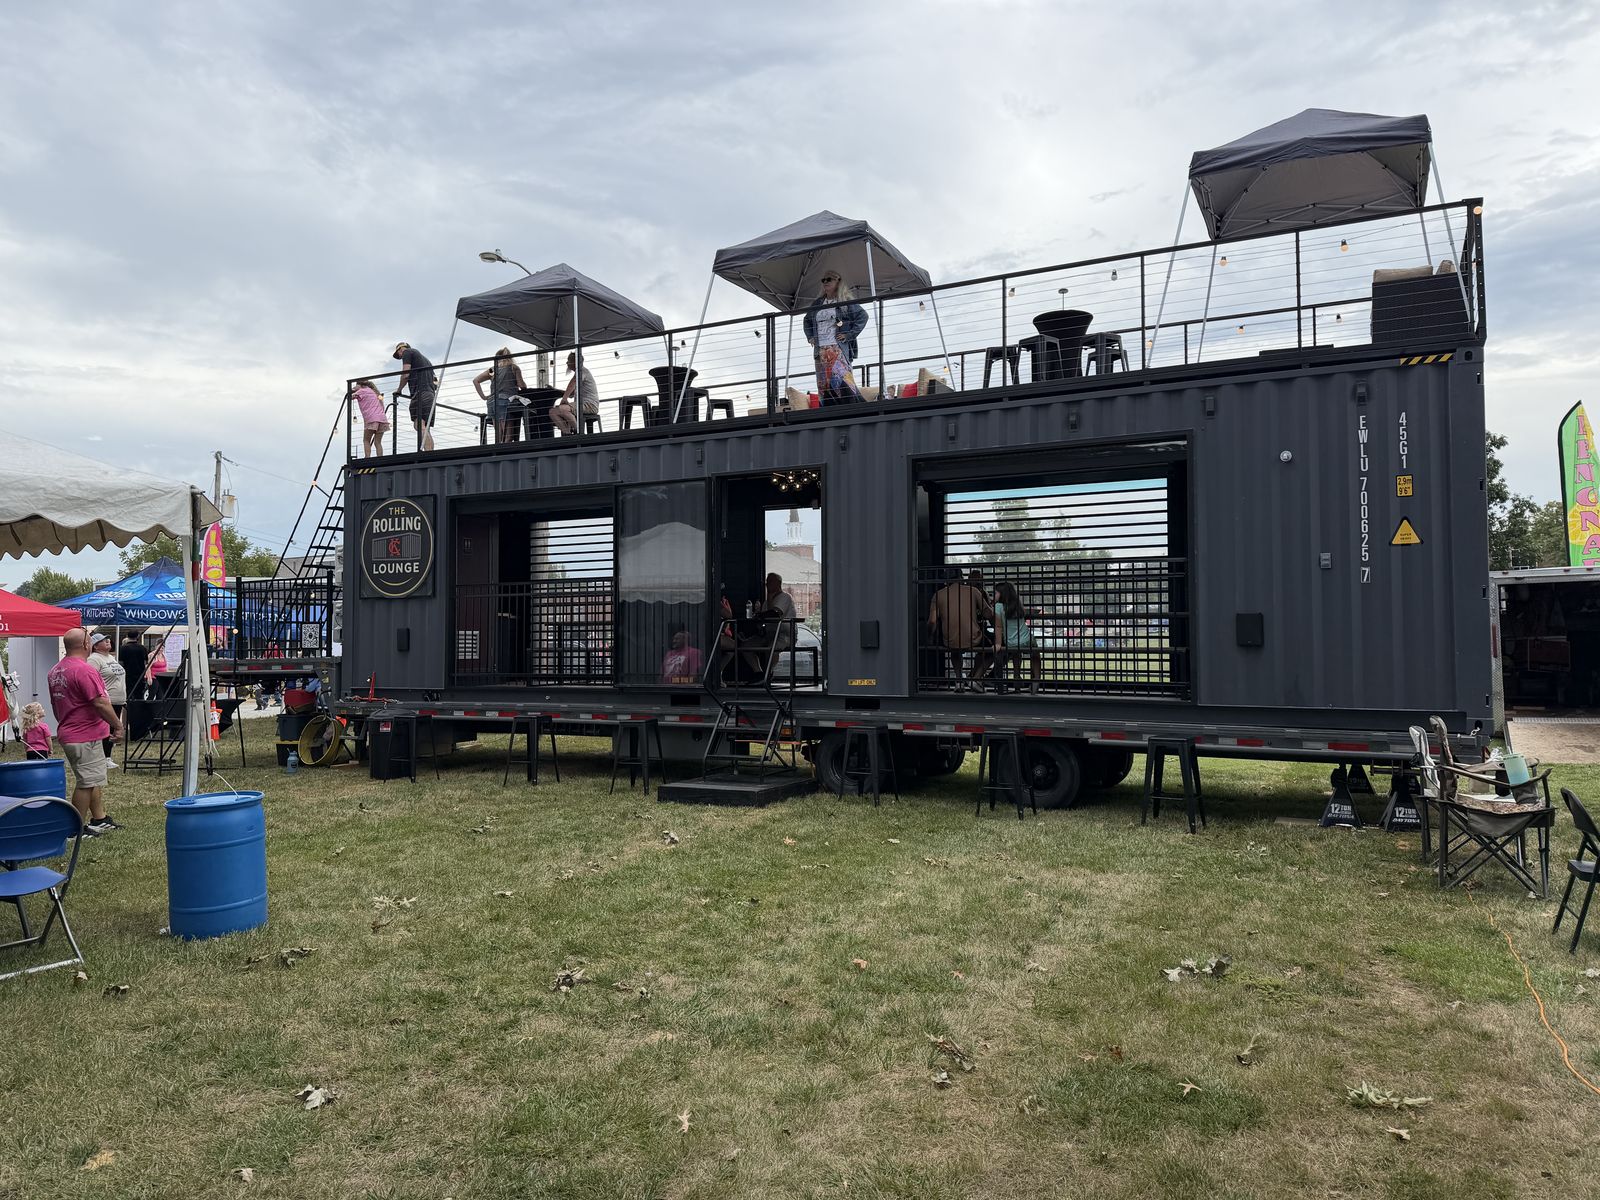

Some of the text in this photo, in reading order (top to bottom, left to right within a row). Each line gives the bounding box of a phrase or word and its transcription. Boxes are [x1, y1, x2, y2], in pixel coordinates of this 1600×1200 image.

[1399, 411, 1408, 469] 45G1
[1358, 415, 1370, 583] EWLU 700625 7
[388, 507, 406, 515] THE
[373, 516, 421, 533] ROLLING
[373, 562, 420, 574] LOUNGE
[124, 609, 185, 620] WINDOWS
[1330, 803, 1341, 814] 12
[1394, 806, 1405, 818] 12
